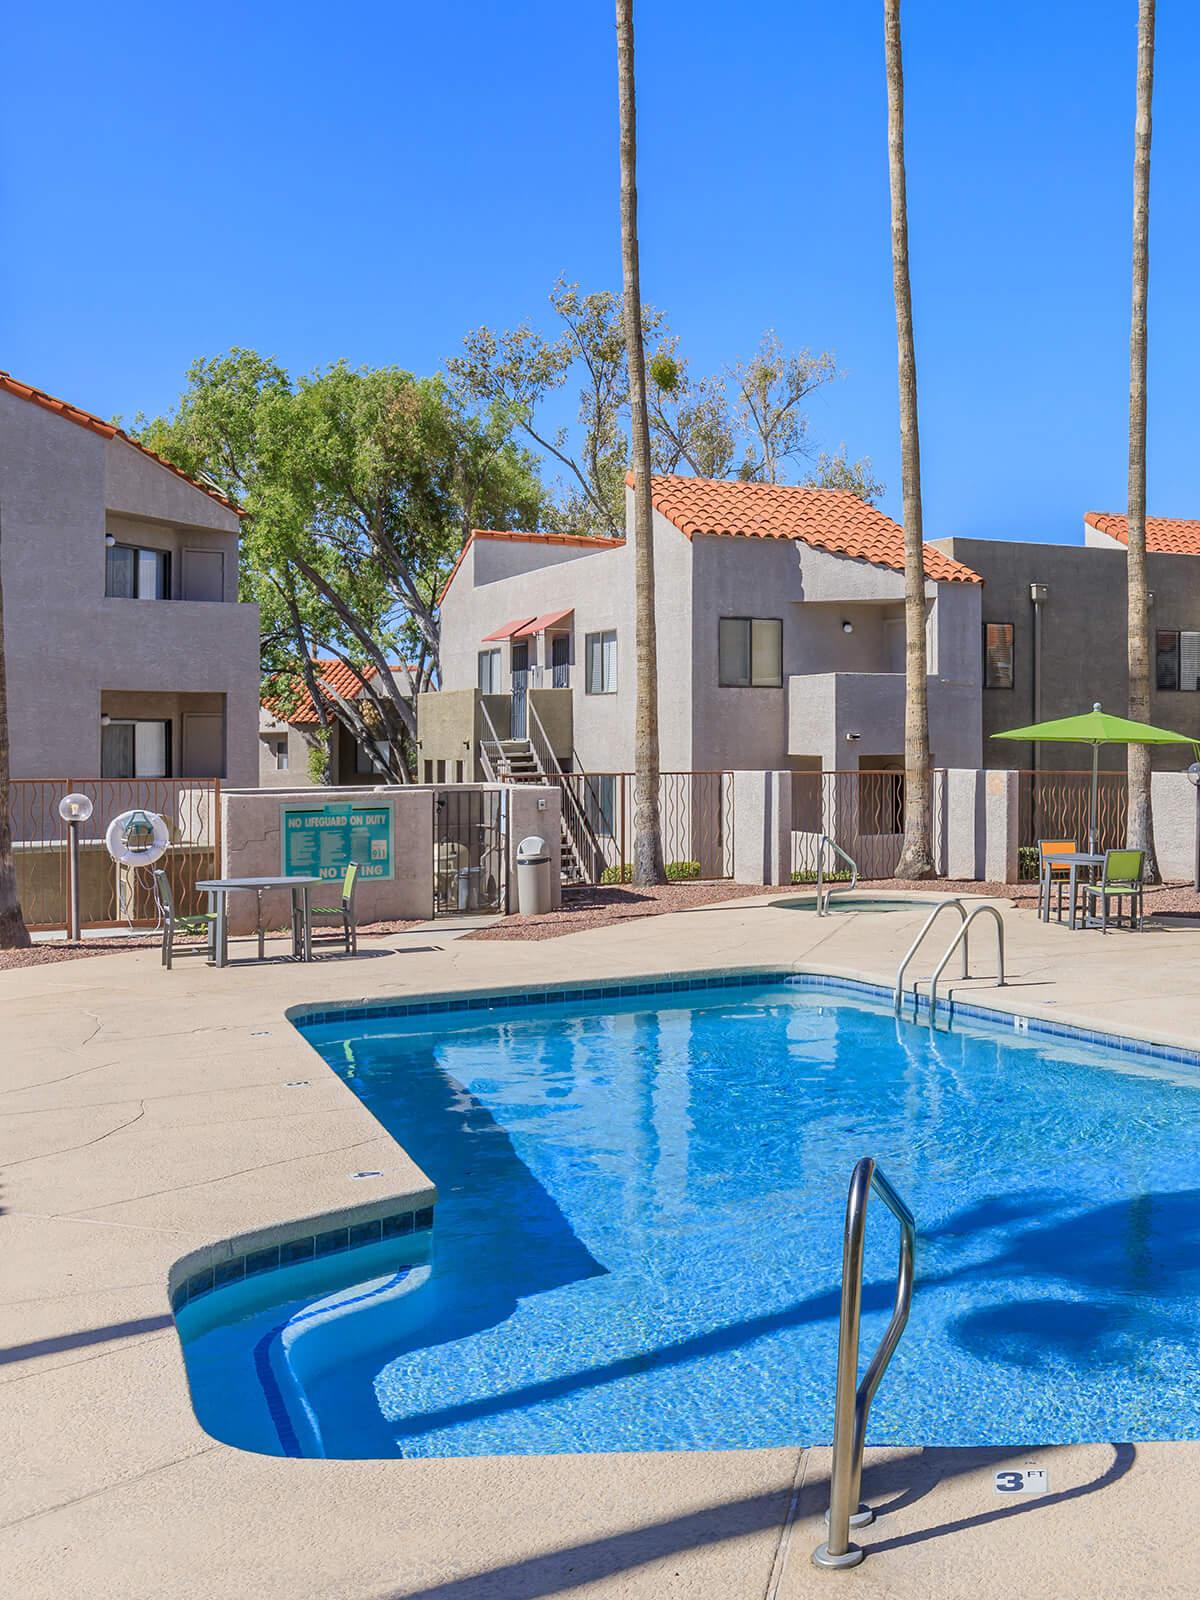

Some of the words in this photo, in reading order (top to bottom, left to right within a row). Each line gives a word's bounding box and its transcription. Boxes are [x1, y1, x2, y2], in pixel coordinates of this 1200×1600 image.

[288, 818, 302, 828] NO
[304, 816, 347, 827] LIFEGUARD
[350, 815, 363, 825] ON
[366, 814, 386, 825] DUTY
[372, 848, 386, 859] 911
[319, 867, 337, 878] NO
[340, 865, 383, 878] DING
[996, 1472, 1024, 1492] 3
[1027, 1470, 1045, 1478] FT
